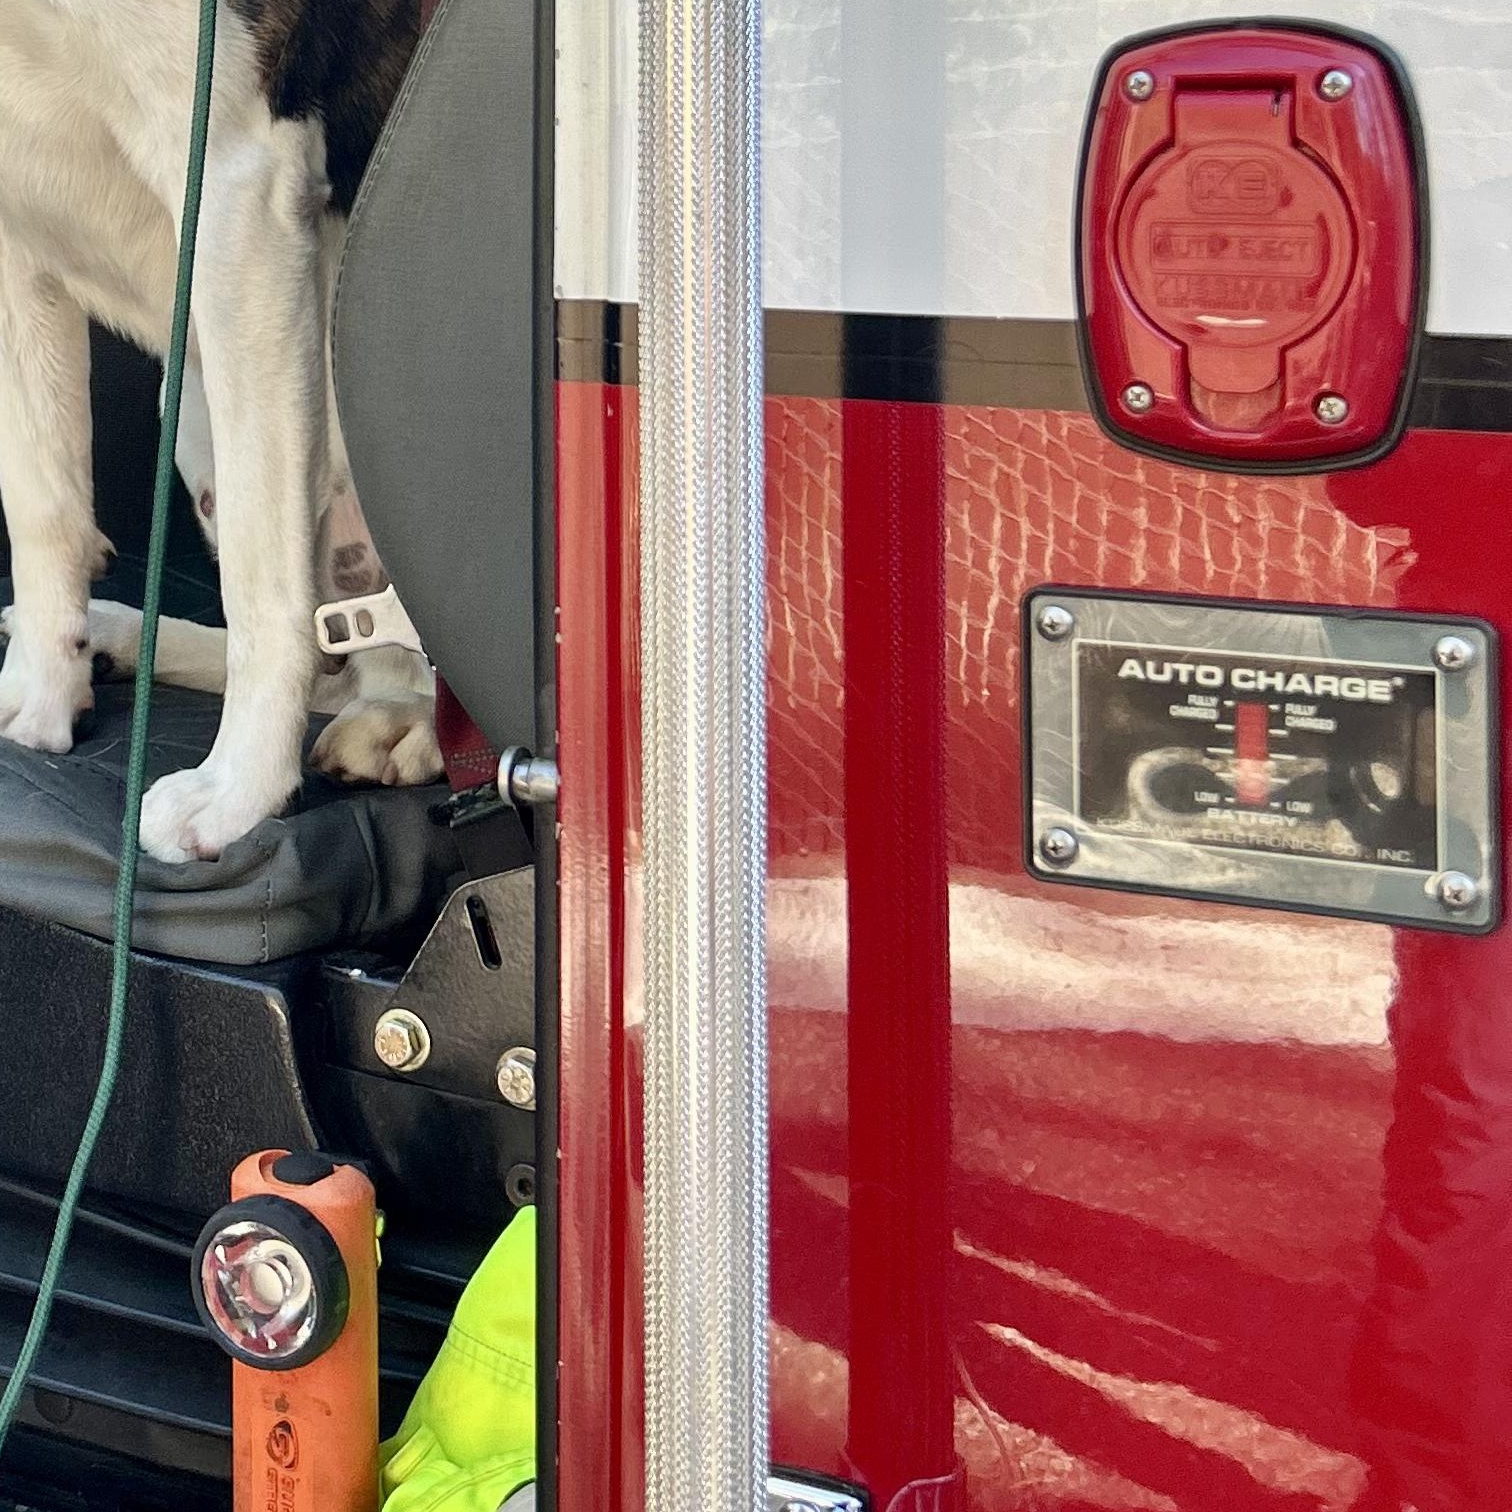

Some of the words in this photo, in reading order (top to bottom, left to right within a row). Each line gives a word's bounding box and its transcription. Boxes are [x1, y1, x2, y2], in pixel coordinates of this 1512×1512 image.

[1153, 235, 1224, 260] AUTO
[1118, 659, 1224, 686] AUTO
[1231, 668, 1393, 703] CHARGE
[1188, 694, 1218, 707] FULLY
[1169, 704, 1220, 721] CHARGED
[1285, 703, 1317, 716] FULLY
[1285, 715, 1337, 731] CHARGED
[1194, 791, 1220, 803] LOW
[1286, 801, 1312, 814] LOW
[1207, 808, 1297, 827] BATTERY
[1202, 831, 1326, 854] ELECTRONICS
